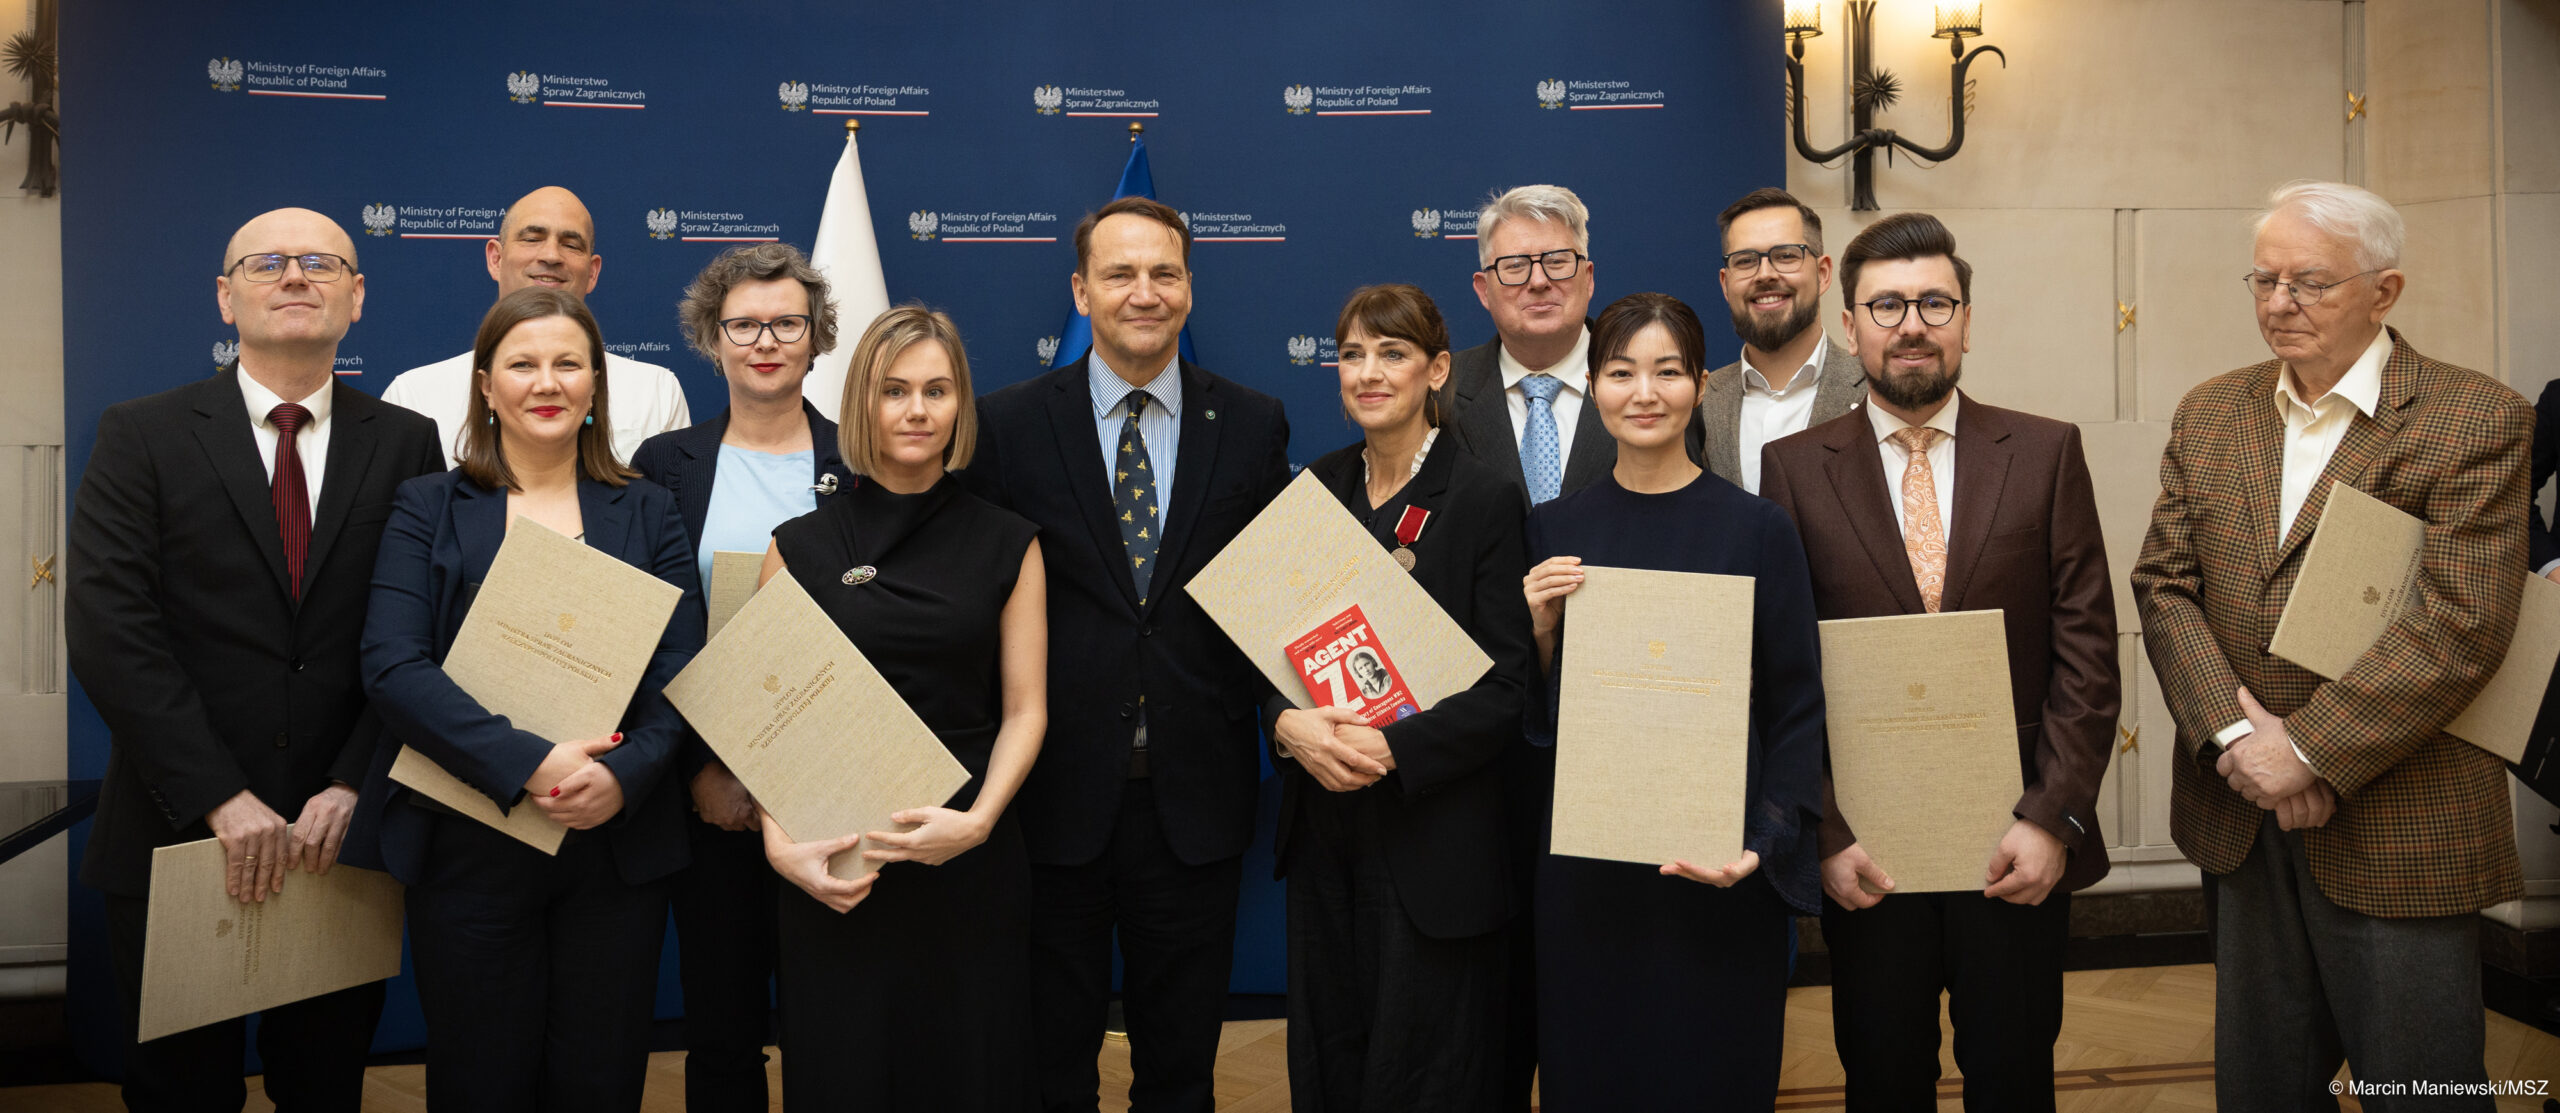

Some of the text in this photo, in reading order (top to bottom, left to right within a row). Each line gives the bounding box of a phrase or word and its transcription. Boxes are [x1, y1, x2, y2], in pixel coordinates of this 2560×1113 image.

[247, 60, 387, 79] Ministry of Foreign Affairs
[247, 73, 348, 89] Republic of Poland
[542, 74, 609, 87] Ministerstwo
[1569, 79, 1630, 90] Ministerstwo
[542, 85, 646, 101] Spraw Zagranicznych
[812, 83, 930, 98] Ministry of Foreign Affairs
[1065, 87, 1125, 97] Ministerstwo
[1316, 85, 1432, 98] Ministry of Foreign Affairs
[1569, 89, 1664, 102] Spraw Zagranicznych
[812, 94, 896, 107] Republic of Poland
[1065, 98, 1159, 110] Spraw Zagranicznych
[1316, 96, 1398, 109] Republic of Poland
[400, 206, 444, 218] Ministry
[445, 207, 457, 217] of
[458, 207, 497, 219] Foreign
[680, 210, 744, 221] Ministerstwo
[941, 211, 1057, 224] Ministry of Foreign Affairs
[1192, 211, 1252, 222] Ministerstwo
[400, 218, 495, 230] Republic of Poland
[680, 221, 780, 235] Spraw Zagranicznych
[941, 222, 1024, 235] Republic of Poland
[1192, 222, 1286, 234] Spraw Zagranicznych
[1443, 221, 1478, 231] Republi
[638, 342, 671, 351] Affairs
[1320, 349, 1339, 358] Spra
[1303, 623, 1369, 676] AGENT
